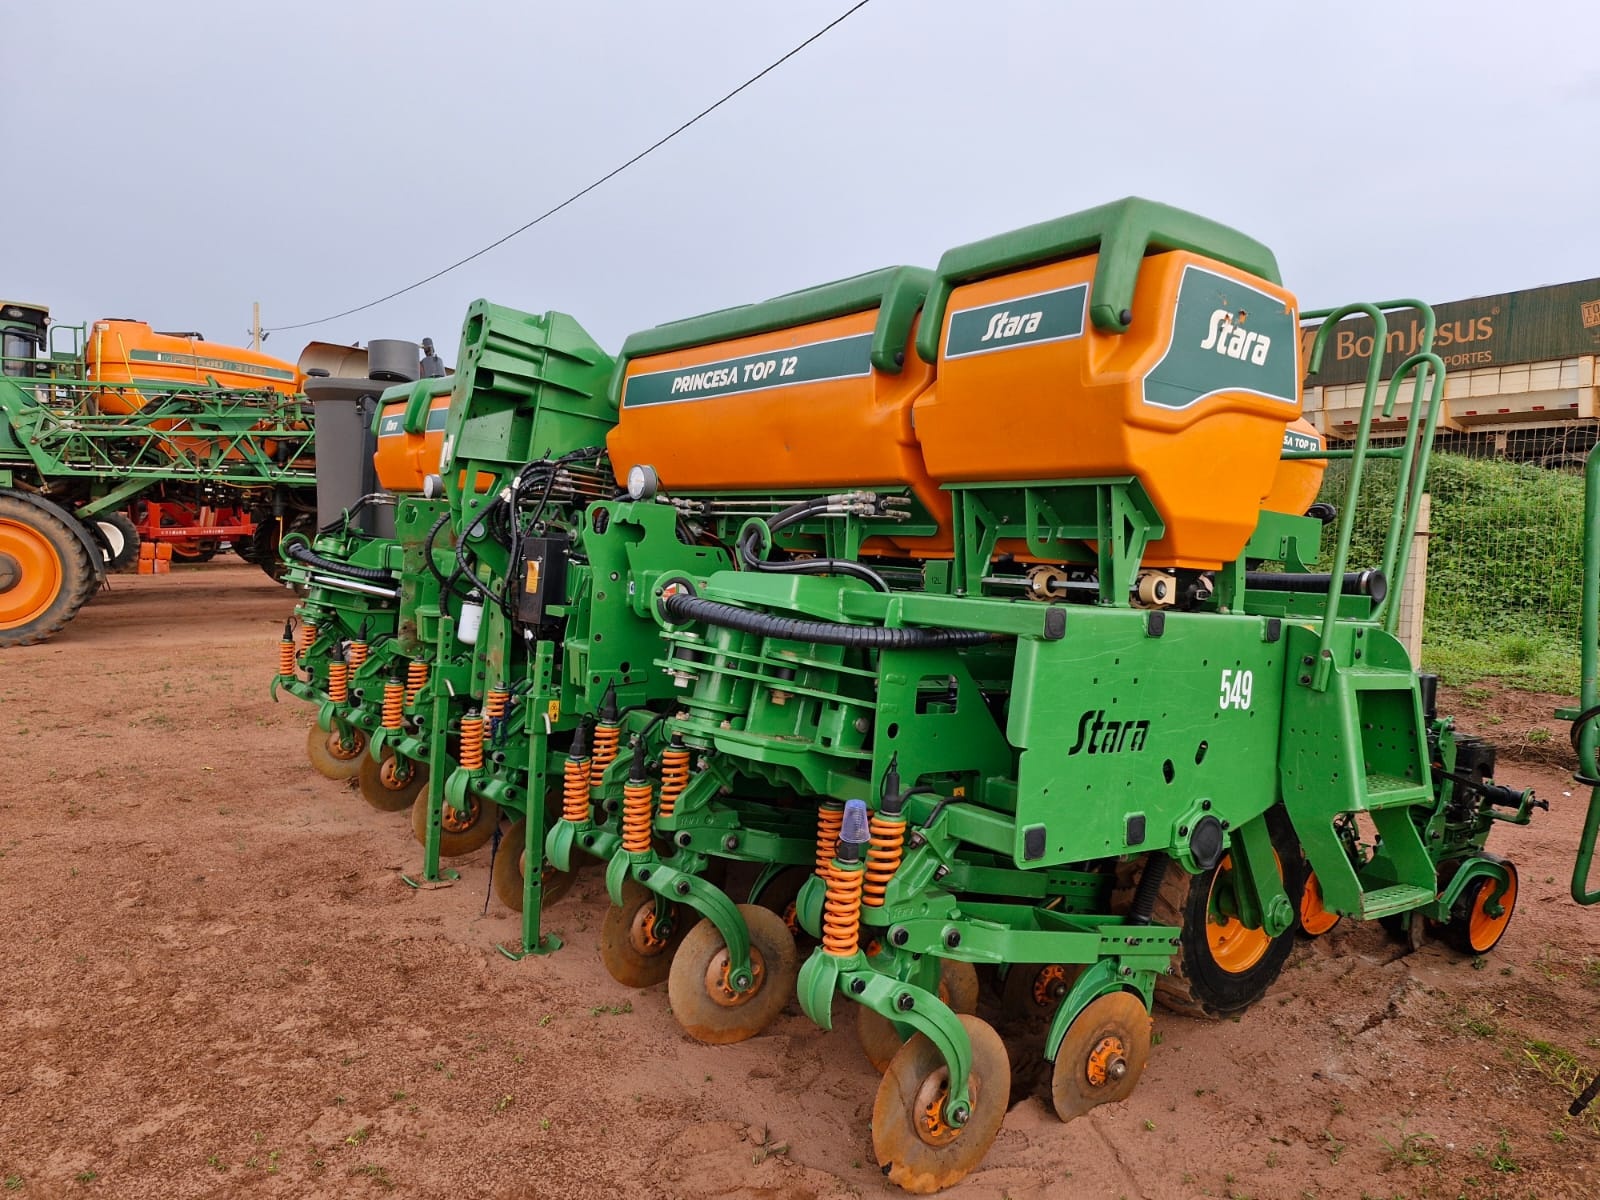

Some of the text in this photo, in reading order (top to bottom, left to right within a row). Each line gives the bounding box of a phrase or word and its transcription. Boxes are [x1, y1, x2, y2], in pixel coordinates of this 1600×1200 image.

[981, 311, 1043, 342] Stara
[1200, 309, 1271, 366] Stara
[671, 356, 798, 394] PRINCESA TOP 12
[1295, 437, 1309, 449] TOP
[1310, 442, 1317, 451] 12
[1219, 669, 1253, 710] 549
[1068, 709, 1151, 756] Stara
